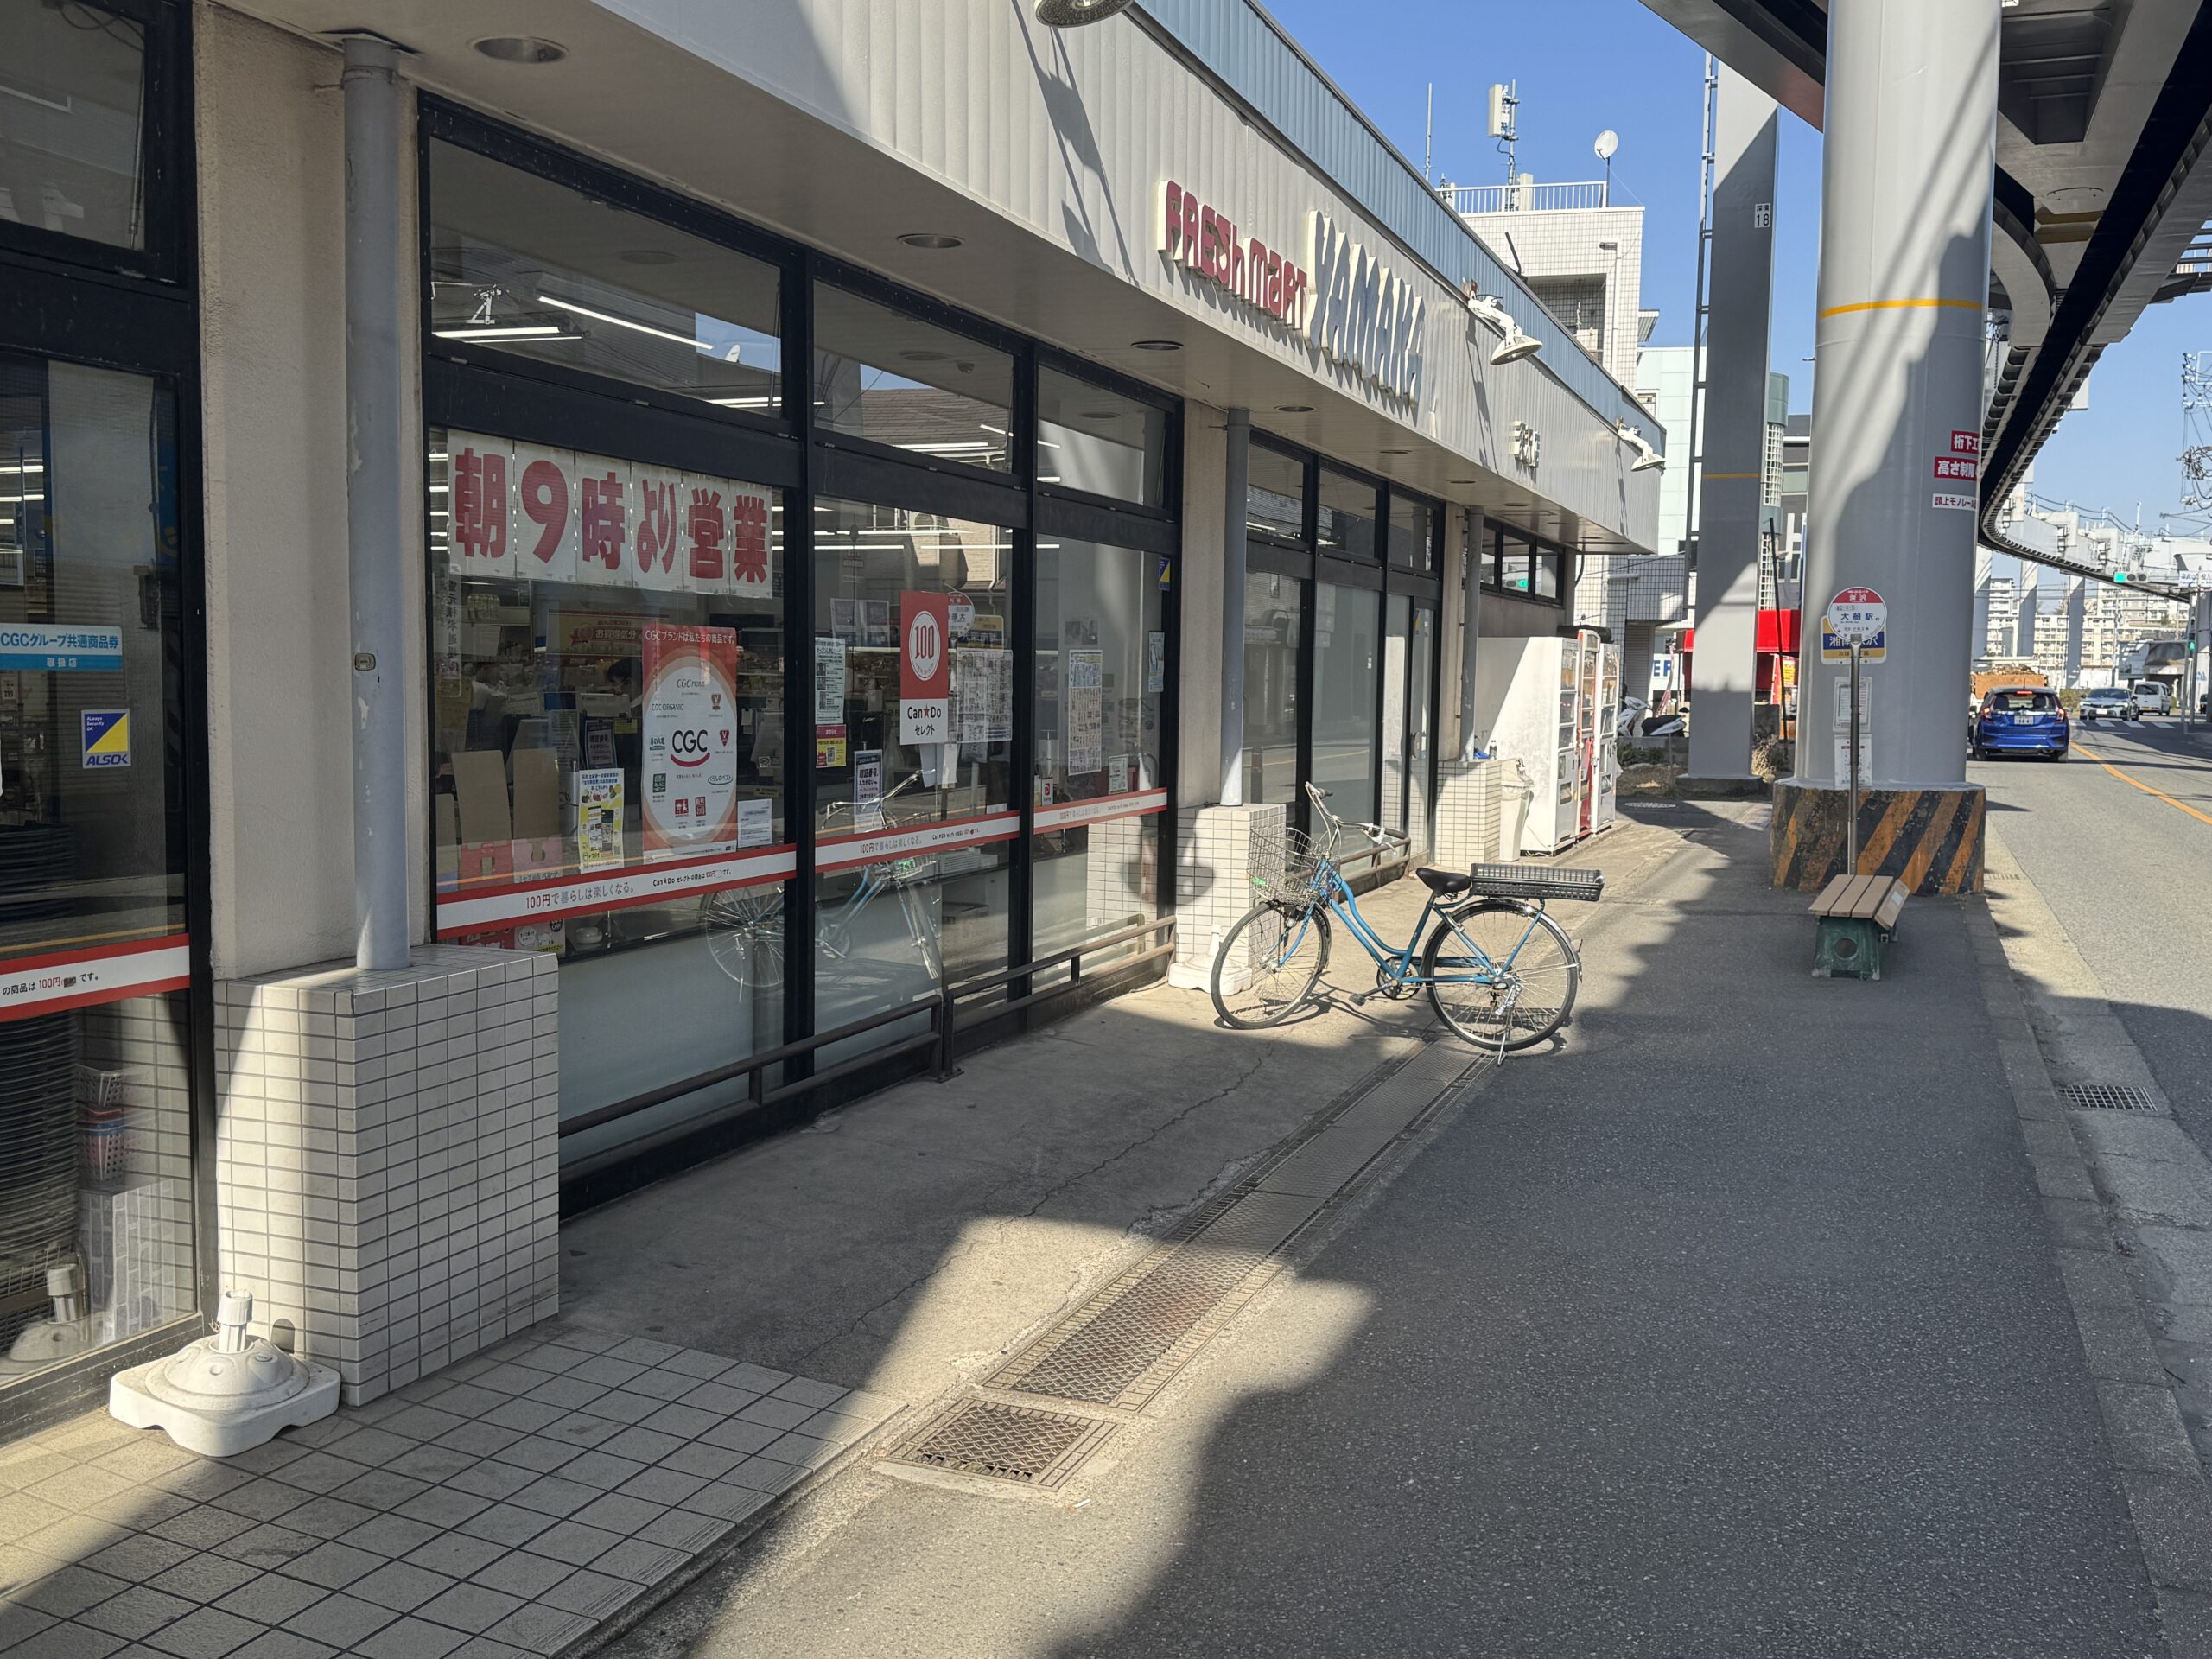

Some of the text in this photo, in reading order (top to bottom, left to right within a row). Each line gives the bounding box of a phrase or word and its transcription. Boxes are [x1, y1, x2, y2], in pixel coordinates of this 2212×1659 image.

[1756, 213, 1770, 226] 18
[454, 446, 768, 584] 朝9時より営業
[0, 632, 119, 650] CGCグループ共通商品券
[915, 624, 935, 660] 100
[914, 724, 936, 735] セレクト
[671, 729, 709, 753] CGC
[86, 753, 128, 766] ALSOK
[525, 881, 634, 909] 100円で暮らしは楽しくなる。
